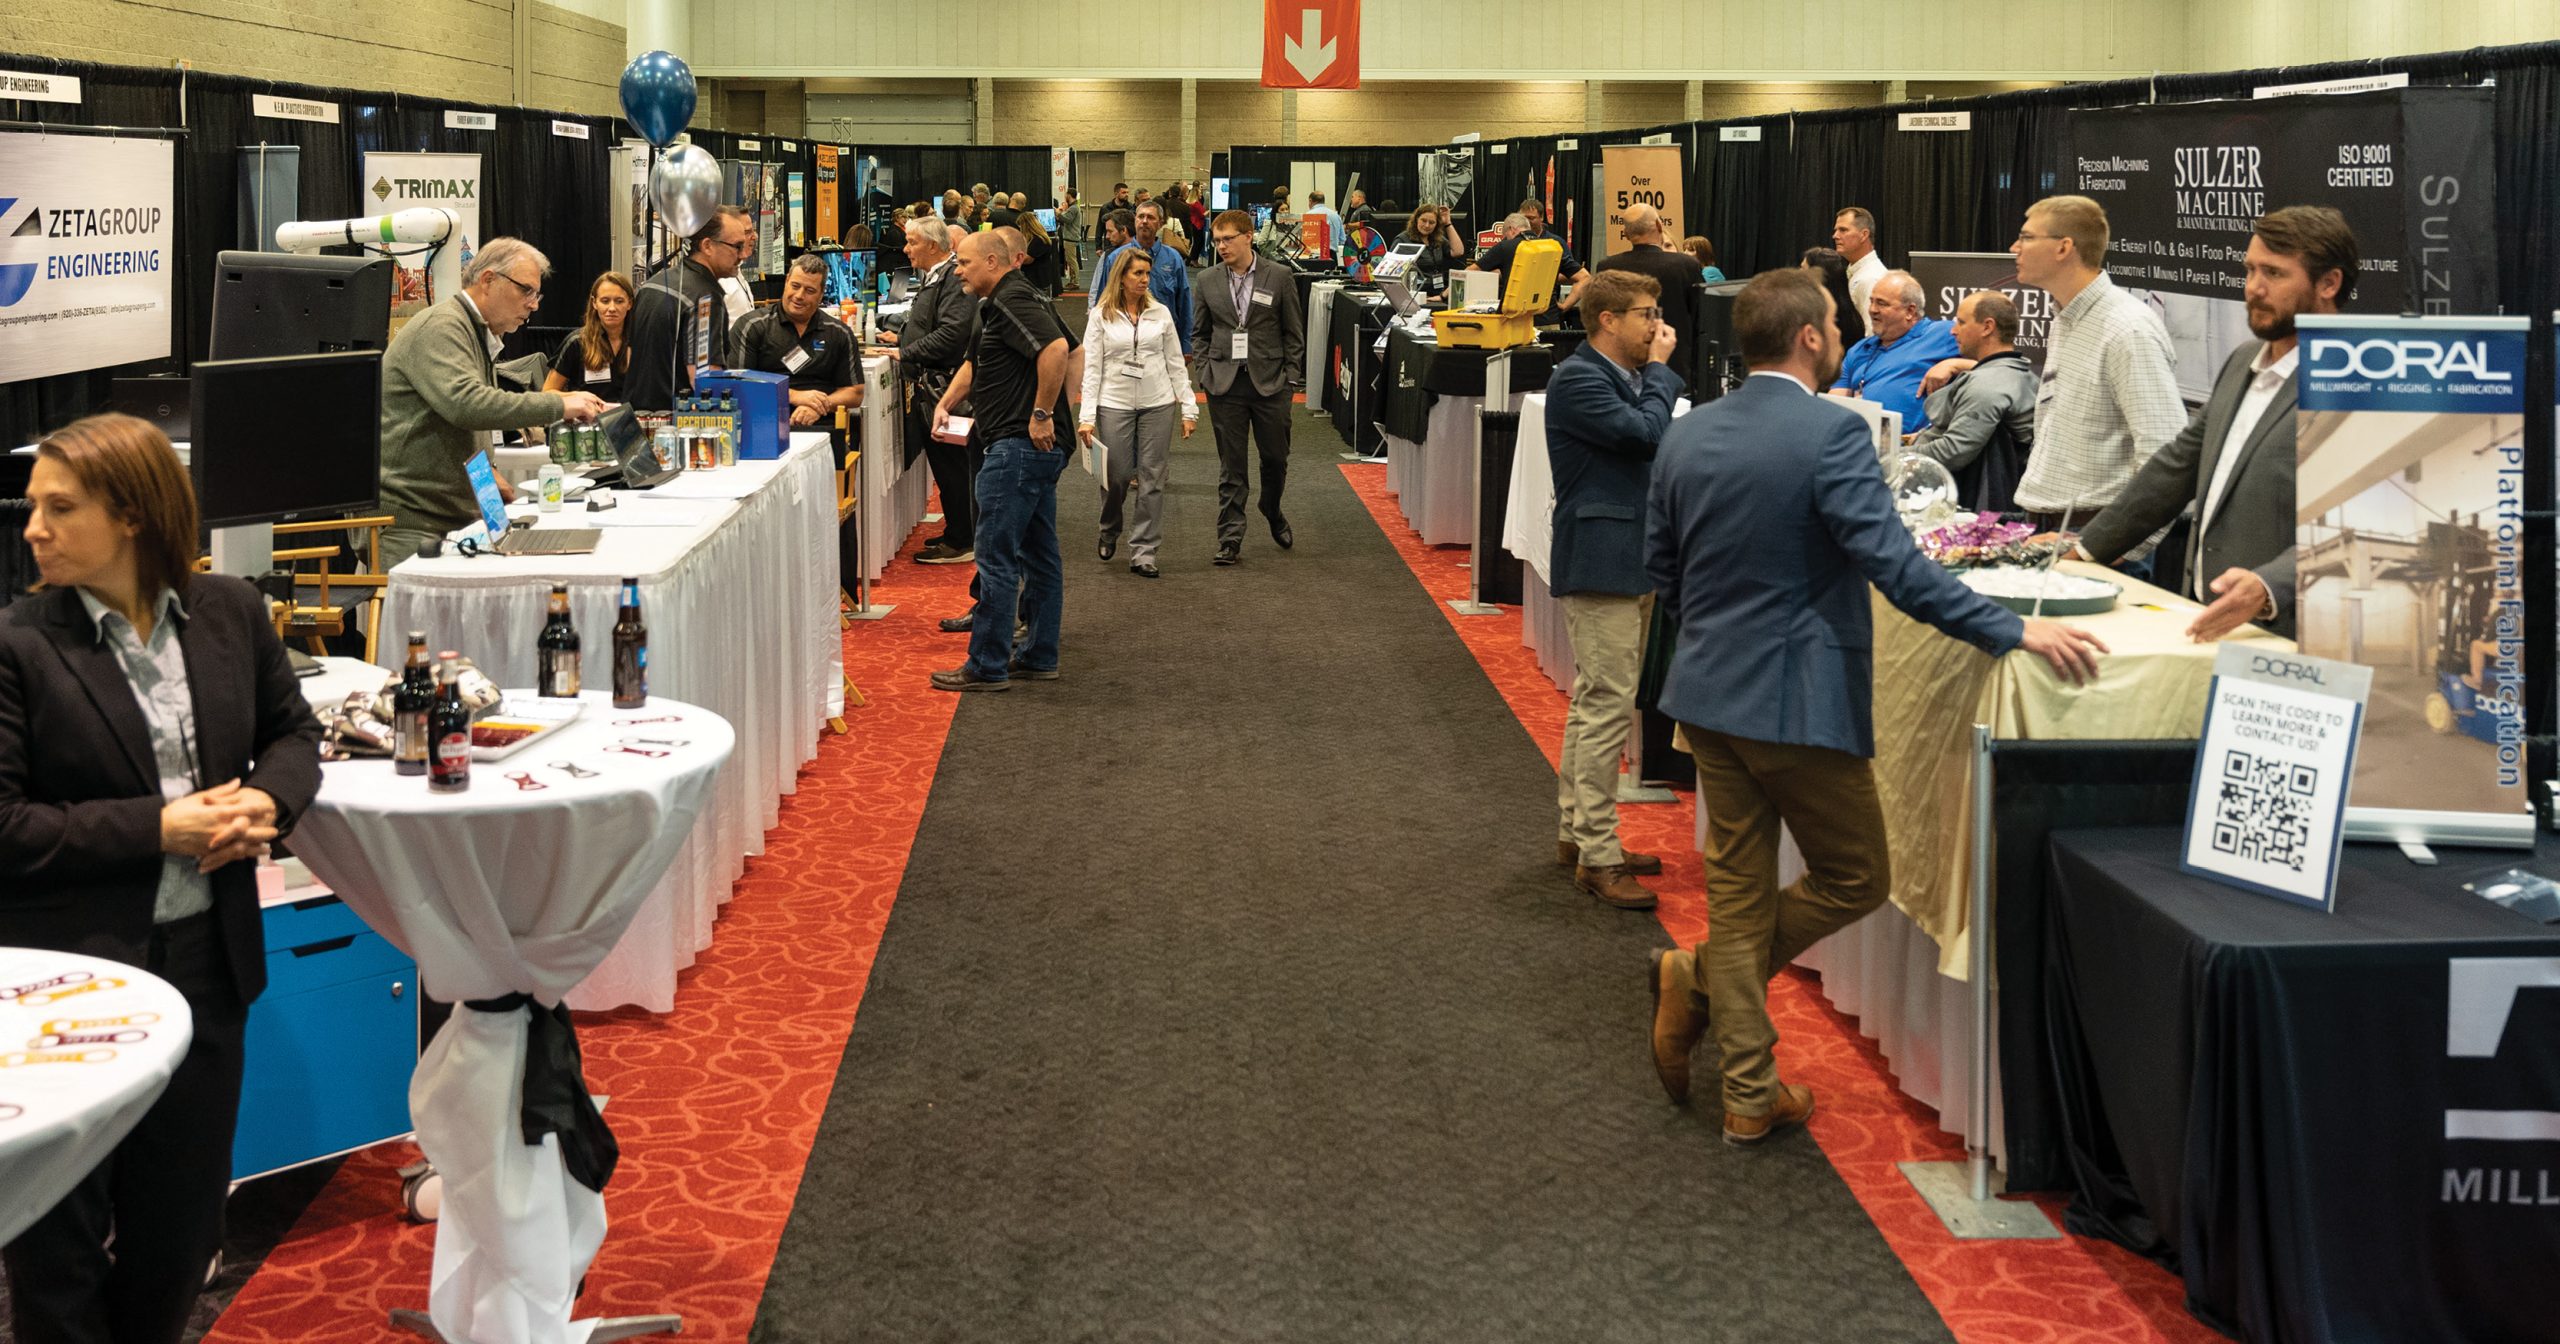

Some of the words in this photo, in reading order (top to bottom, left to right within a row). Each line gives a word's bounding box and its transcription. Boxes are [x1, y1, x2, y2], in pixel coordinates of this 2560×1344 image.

[10, 77, 50, 94] ENGINEERING
[2174, 146, 2264, 188] SULZER
[2339, 145, 2360, 165] ISO
[2362, 144, 2391, 164] 9001
[394, 179, 475, 198] TRIMAX
[1631, 175, 1651, 186] Over
[2079, 175, 2085, 190] &
[2327, 167, 2394, 187] CERTIFIED
[2176, 190, 2265, 218] MACHINE
[48, 207, 161, 239] ZETAGROUP
[2169, 242, 2175, 256] &
[47, 249, 160, 280] ENGINEERING
[2310, 339, 2512, 380] DORAL
[2388, 383, 2432, 393] RIGGING
[2448, 384, 2513, 395] FABRICATION
[2498, 447, 2524, 587] Platform
[2252, 655, 2326, 686] DORAL
[2497, 599, 2527, 788] Fabrication
[2223, 693, 2256, 709] SCAN
[2259, 700, 2282, 715] THE
[2286, 705, 2321, 722] CODE
[2325, 713, 2344, 727] TO
[2232, 709, 2273, 728] LEARN
[2276, 718, 2313, 737] MORE
[2317, 727, 2327, 739] &
[2235, 724, 2295, 746] CONTACT
[2298, 738, 2320, 751] US!
